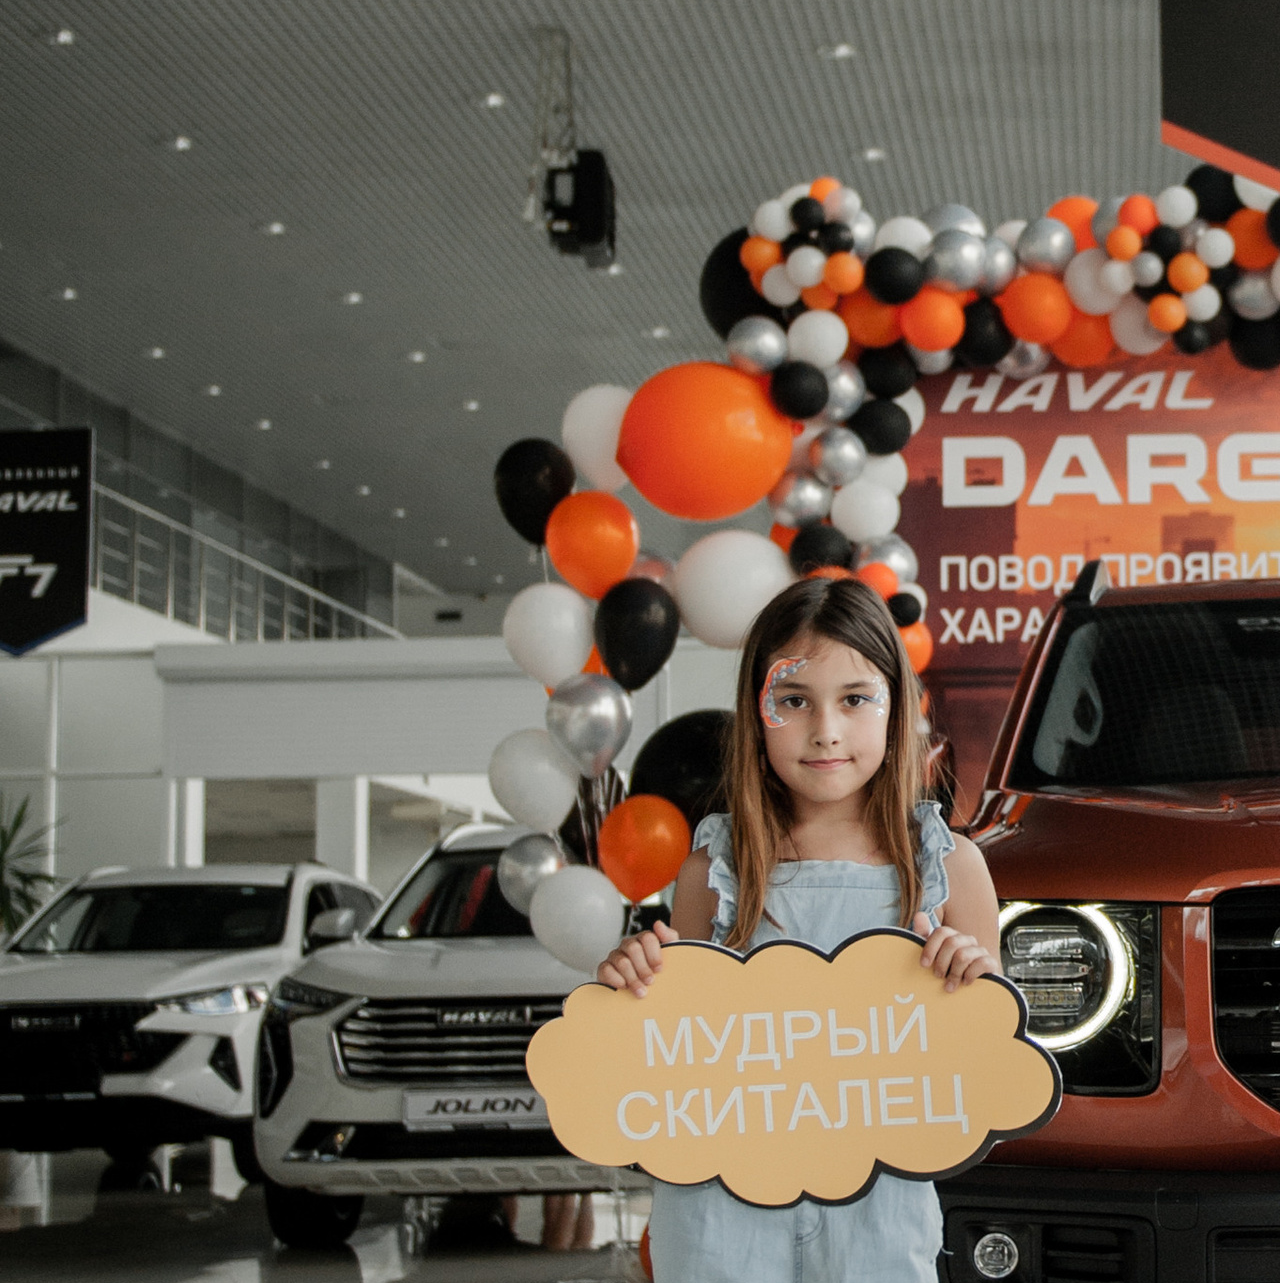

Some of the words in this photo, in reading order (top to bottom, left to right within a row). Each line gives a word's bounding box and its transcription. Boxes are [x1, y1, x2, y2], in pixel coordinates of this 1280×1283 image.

[940, 370, 1215, 413] HAVAL
[939, 554, 1085, 597] ПОВОД
[644, 994, 928, 1072] МУДРЫЙ
[427, 1097, 536, 1116] JOLION
[617, 1074, 969, 1140] СКИТАЛЕЦ
